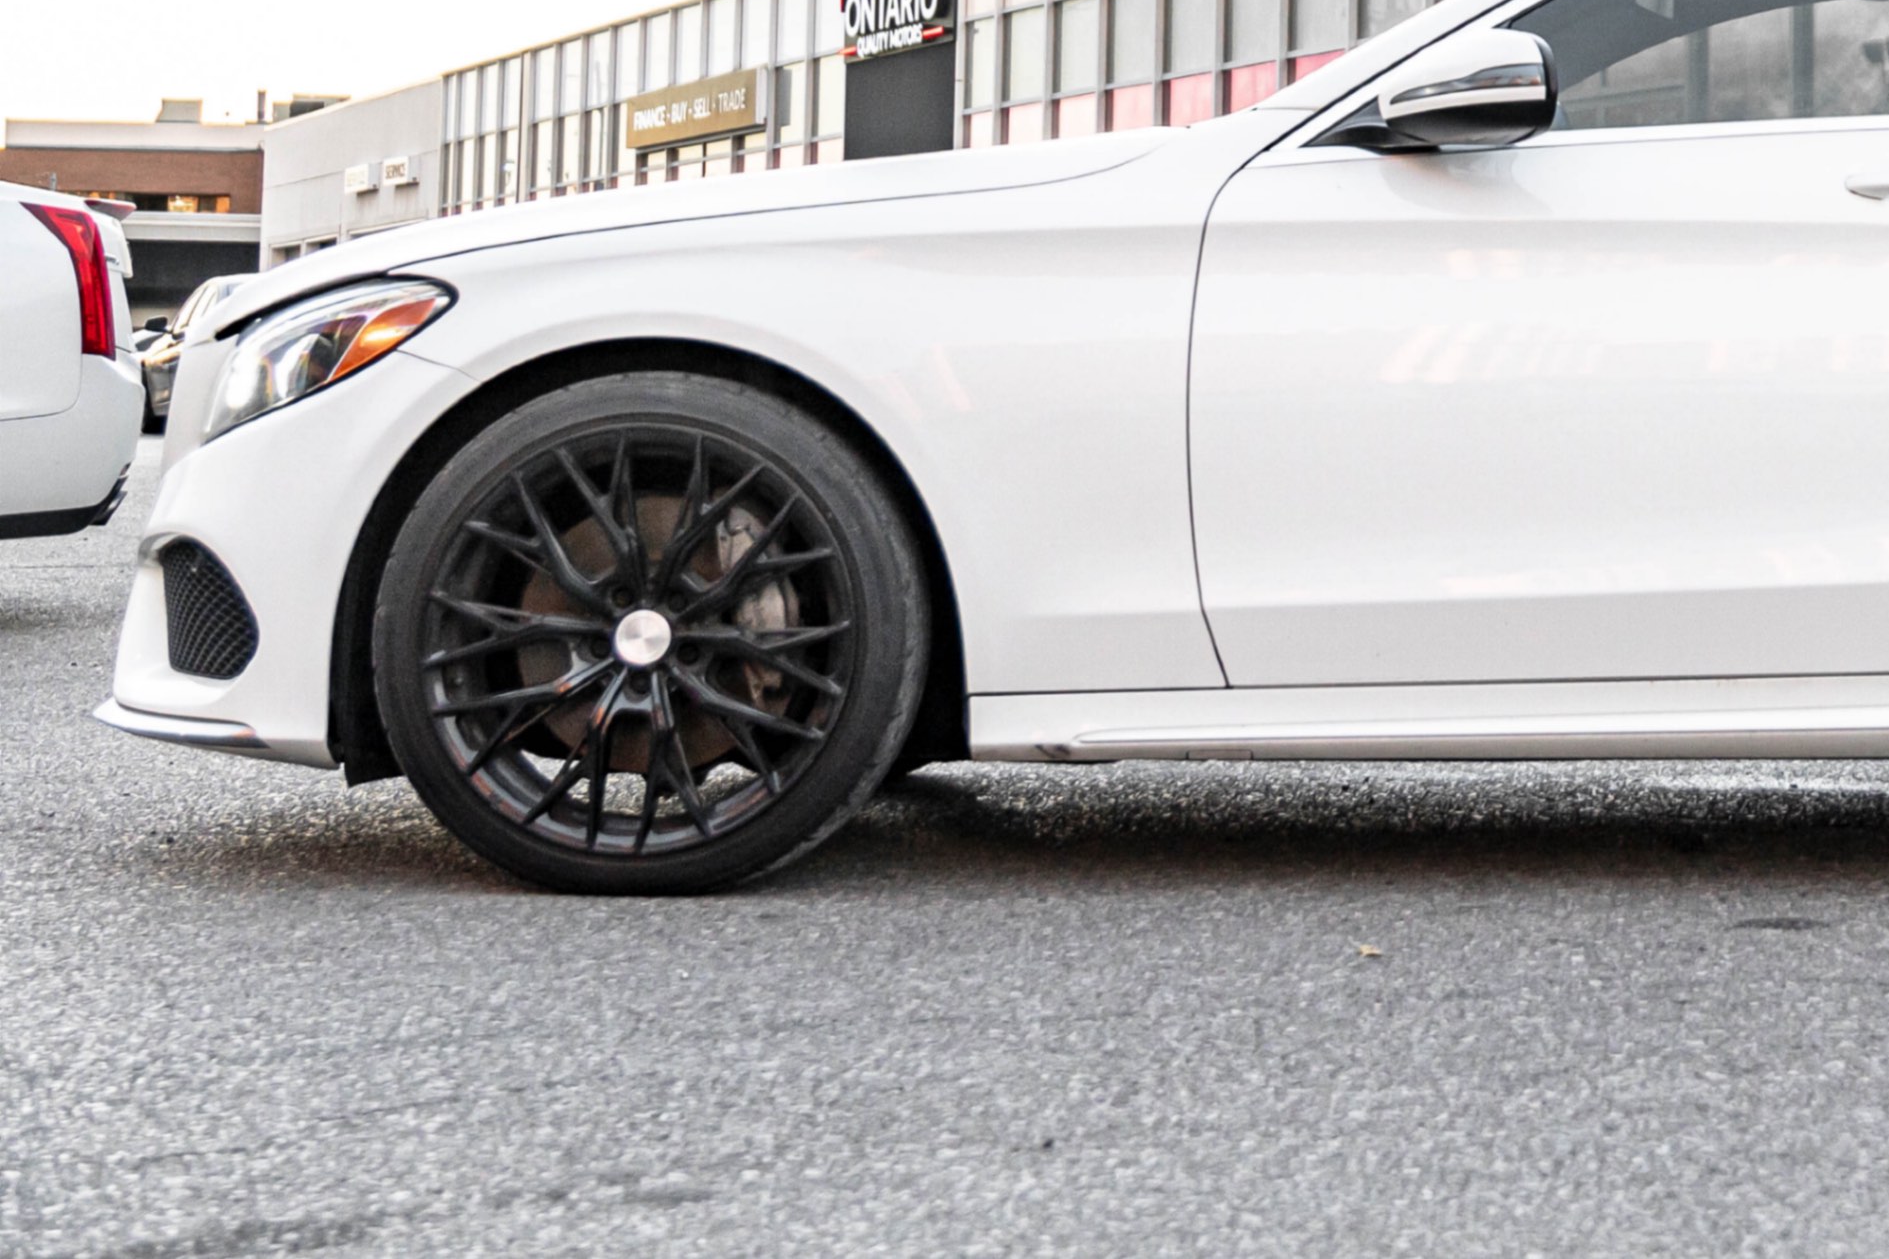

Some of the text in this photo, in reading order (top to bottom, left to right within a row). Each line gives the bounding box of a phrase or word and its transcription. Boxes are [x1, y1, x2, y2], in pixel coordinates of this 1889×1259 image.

[856, 30, 888, 58] QUALITY
[633, 88, 746, 131] FINANCE BUY SELL TRADE
